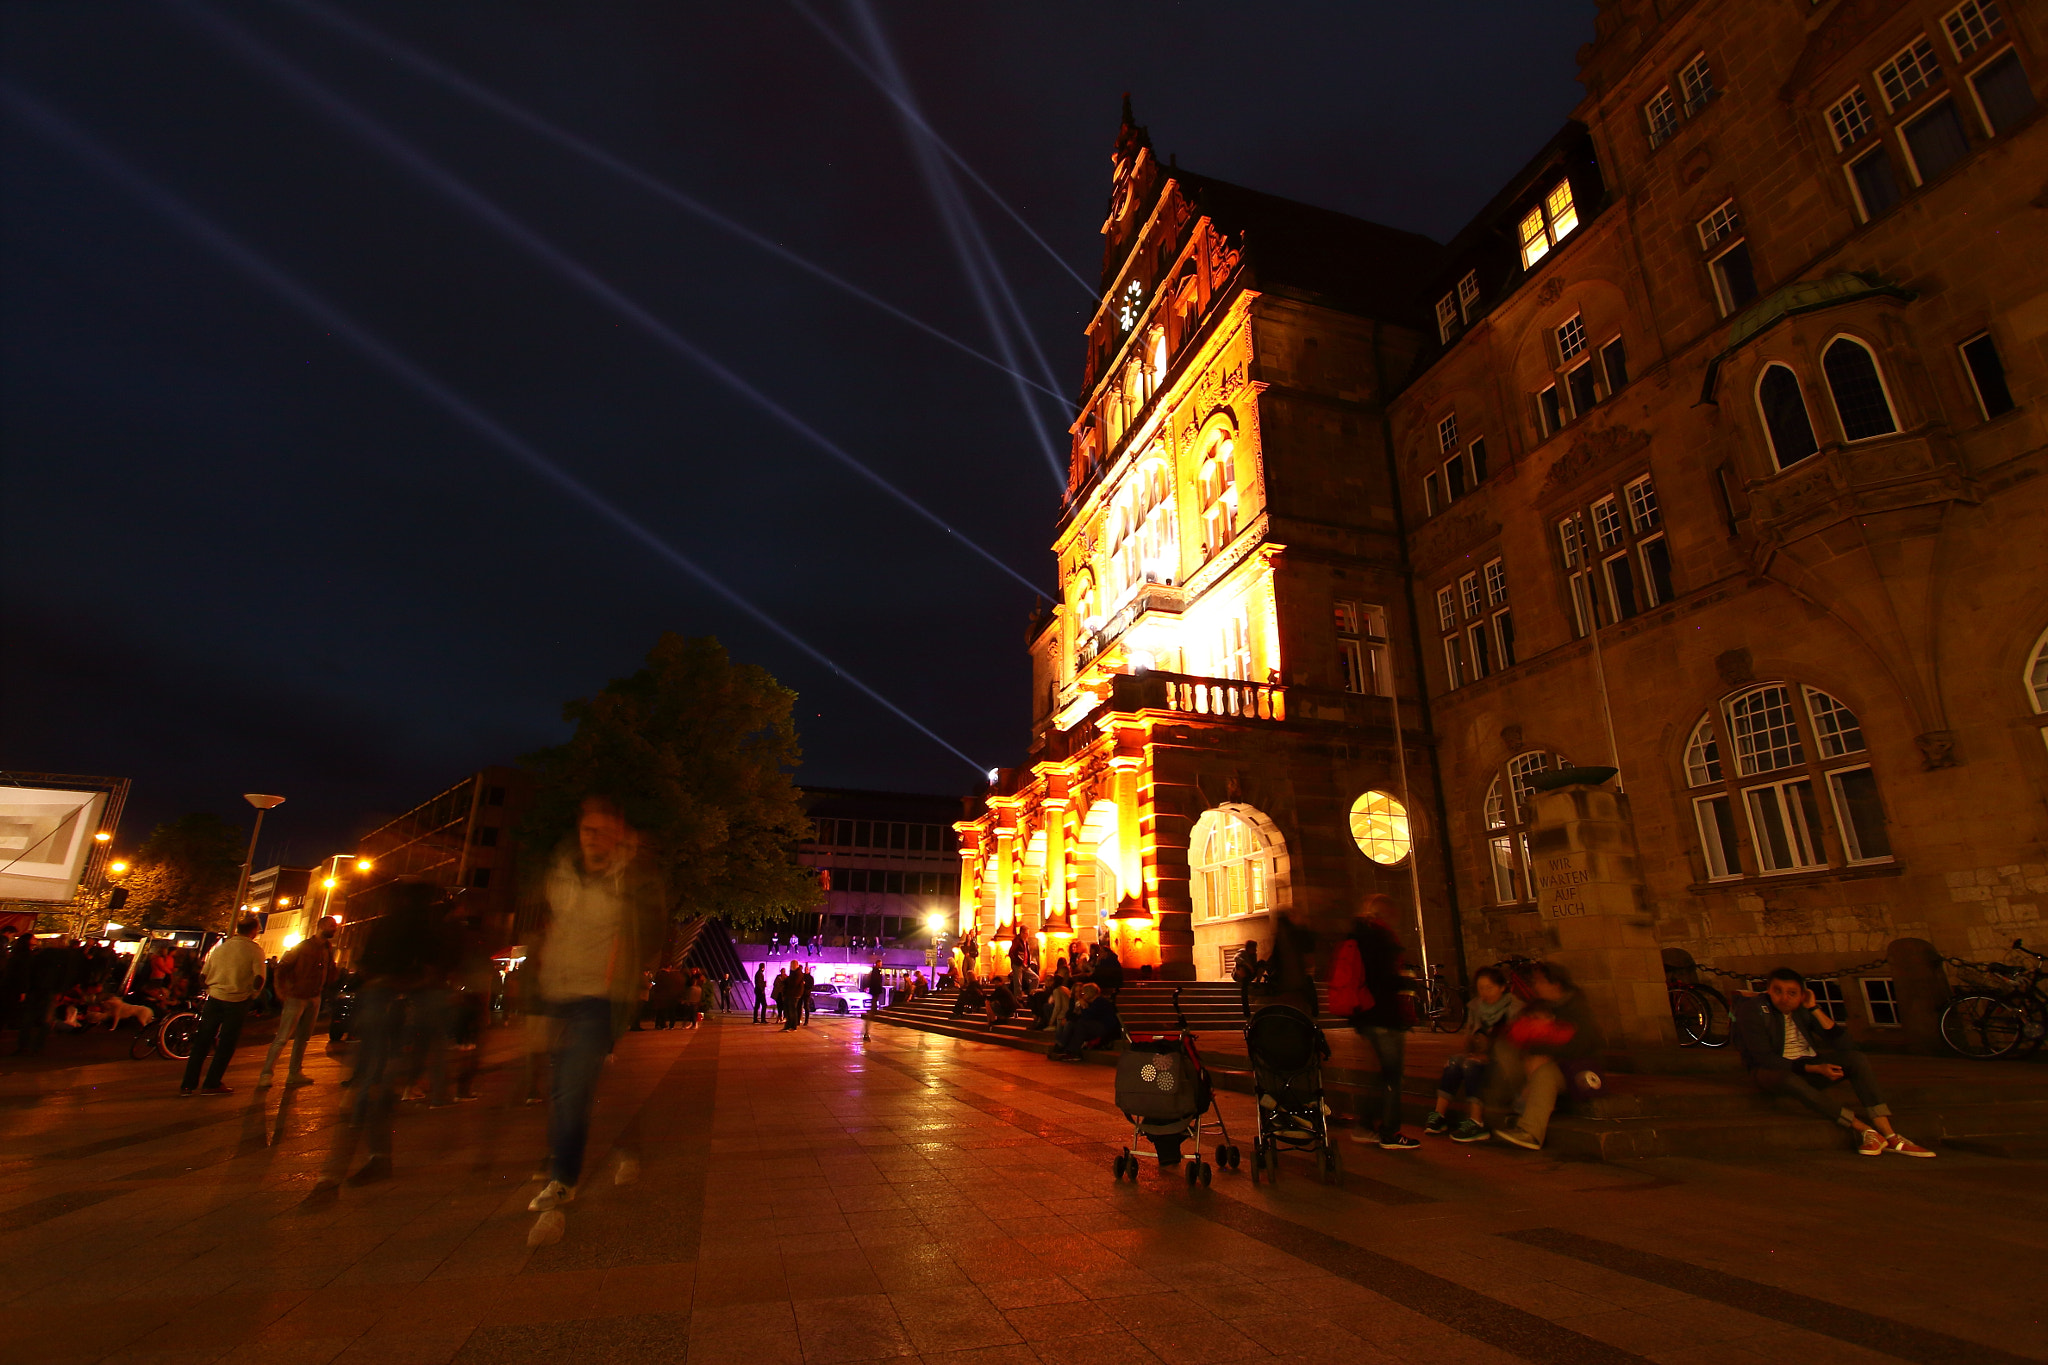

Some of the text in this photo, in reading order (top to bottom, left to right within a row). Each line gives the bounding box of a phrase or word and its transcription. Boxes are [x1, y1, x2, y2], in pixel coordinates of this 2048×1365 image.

[1550, 858, 1571, 871] WIR
[1540, 870, 1588, 888] WARTEN
[1555, 888, 1576, 902] AUF
[1552, 902, 1585, 918] EUCH
